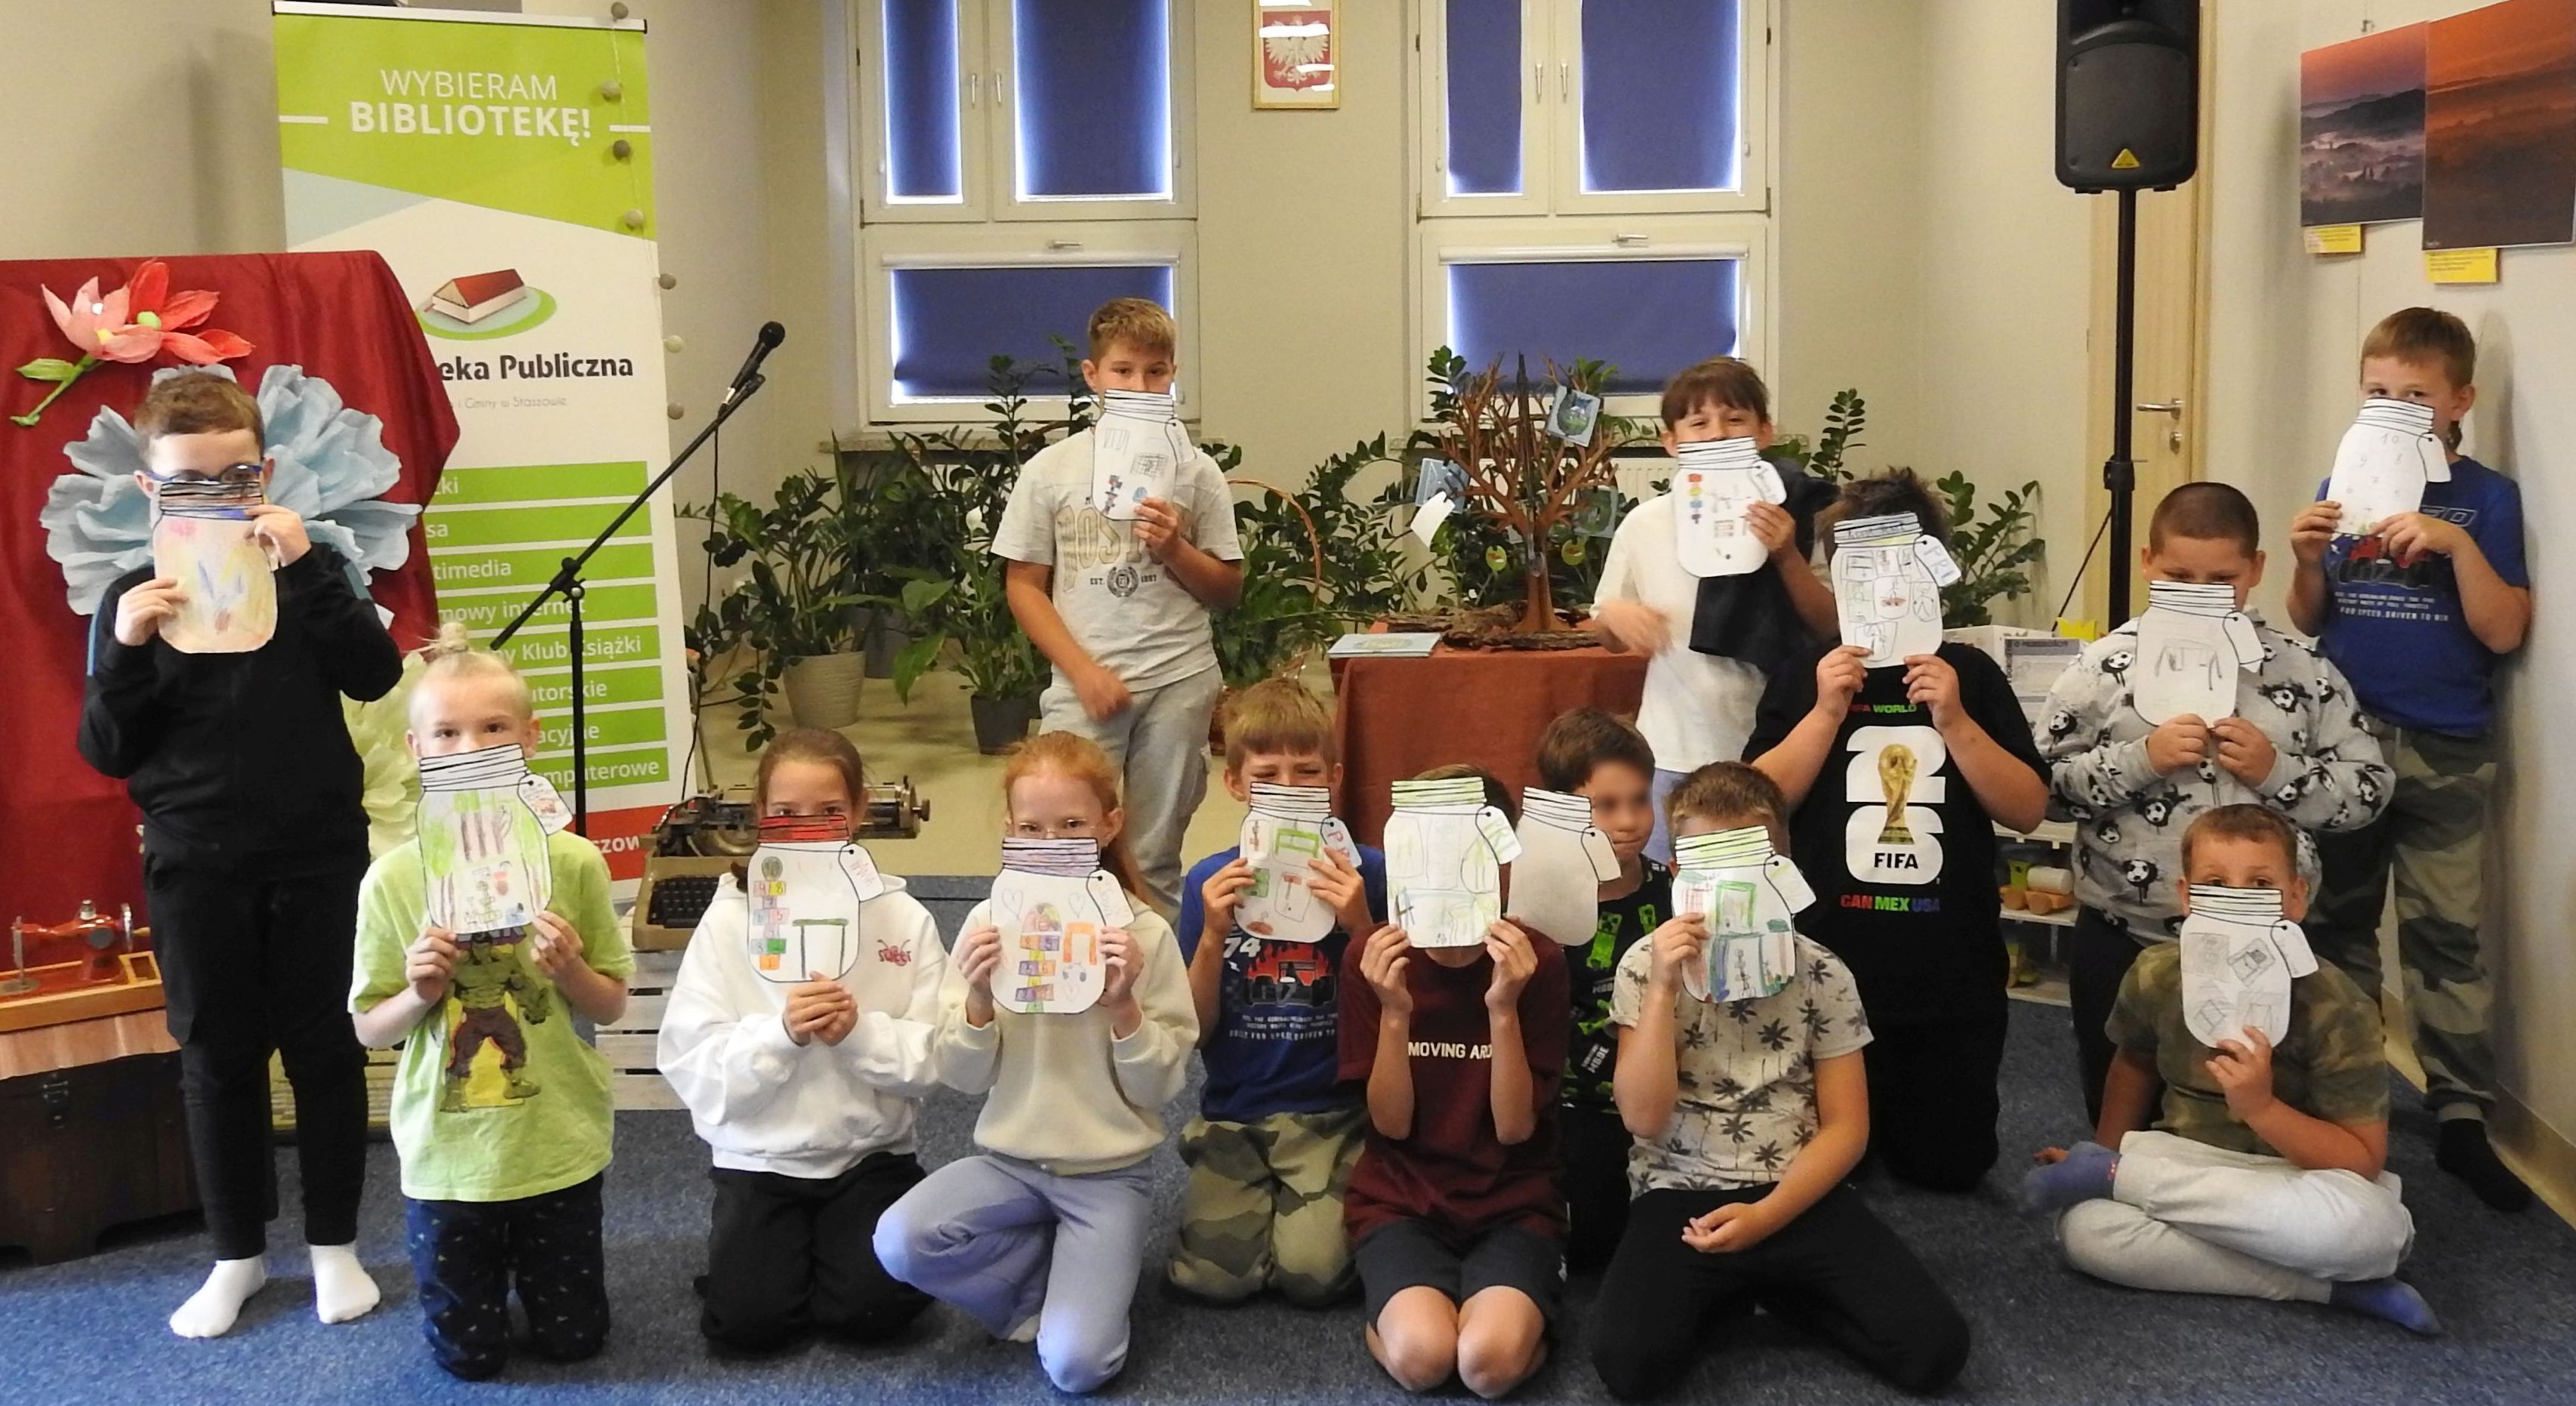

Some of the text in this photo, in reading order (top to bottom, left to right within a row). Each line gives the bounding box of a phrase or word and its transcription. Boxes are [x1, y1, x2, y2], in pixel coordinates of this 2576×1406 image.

[380, 69, 558, 100] WYBIERAM
[350, 101, 591, 146] BIBLIOTEKĘ!
[438, 352, 633, 381] eka Publiczna
[434, 476, 459, 495] ki
[426, 523, 449, 538] sa
[432, 560, 513, 581] timedia
[438, 606, 497, 624] mowy
[522, 640, 568, 661] Klub
[1872, 704, 1918, 714] WORLD
[1873, 853, 1919, 870] FIFA
[1840, 894, 1873, 910] CAN
[1874, 896, 1910, 911] MEX
[1223, 937, 1261, 958] 74
[1407, 1041, 1466, 1059] MOVING
